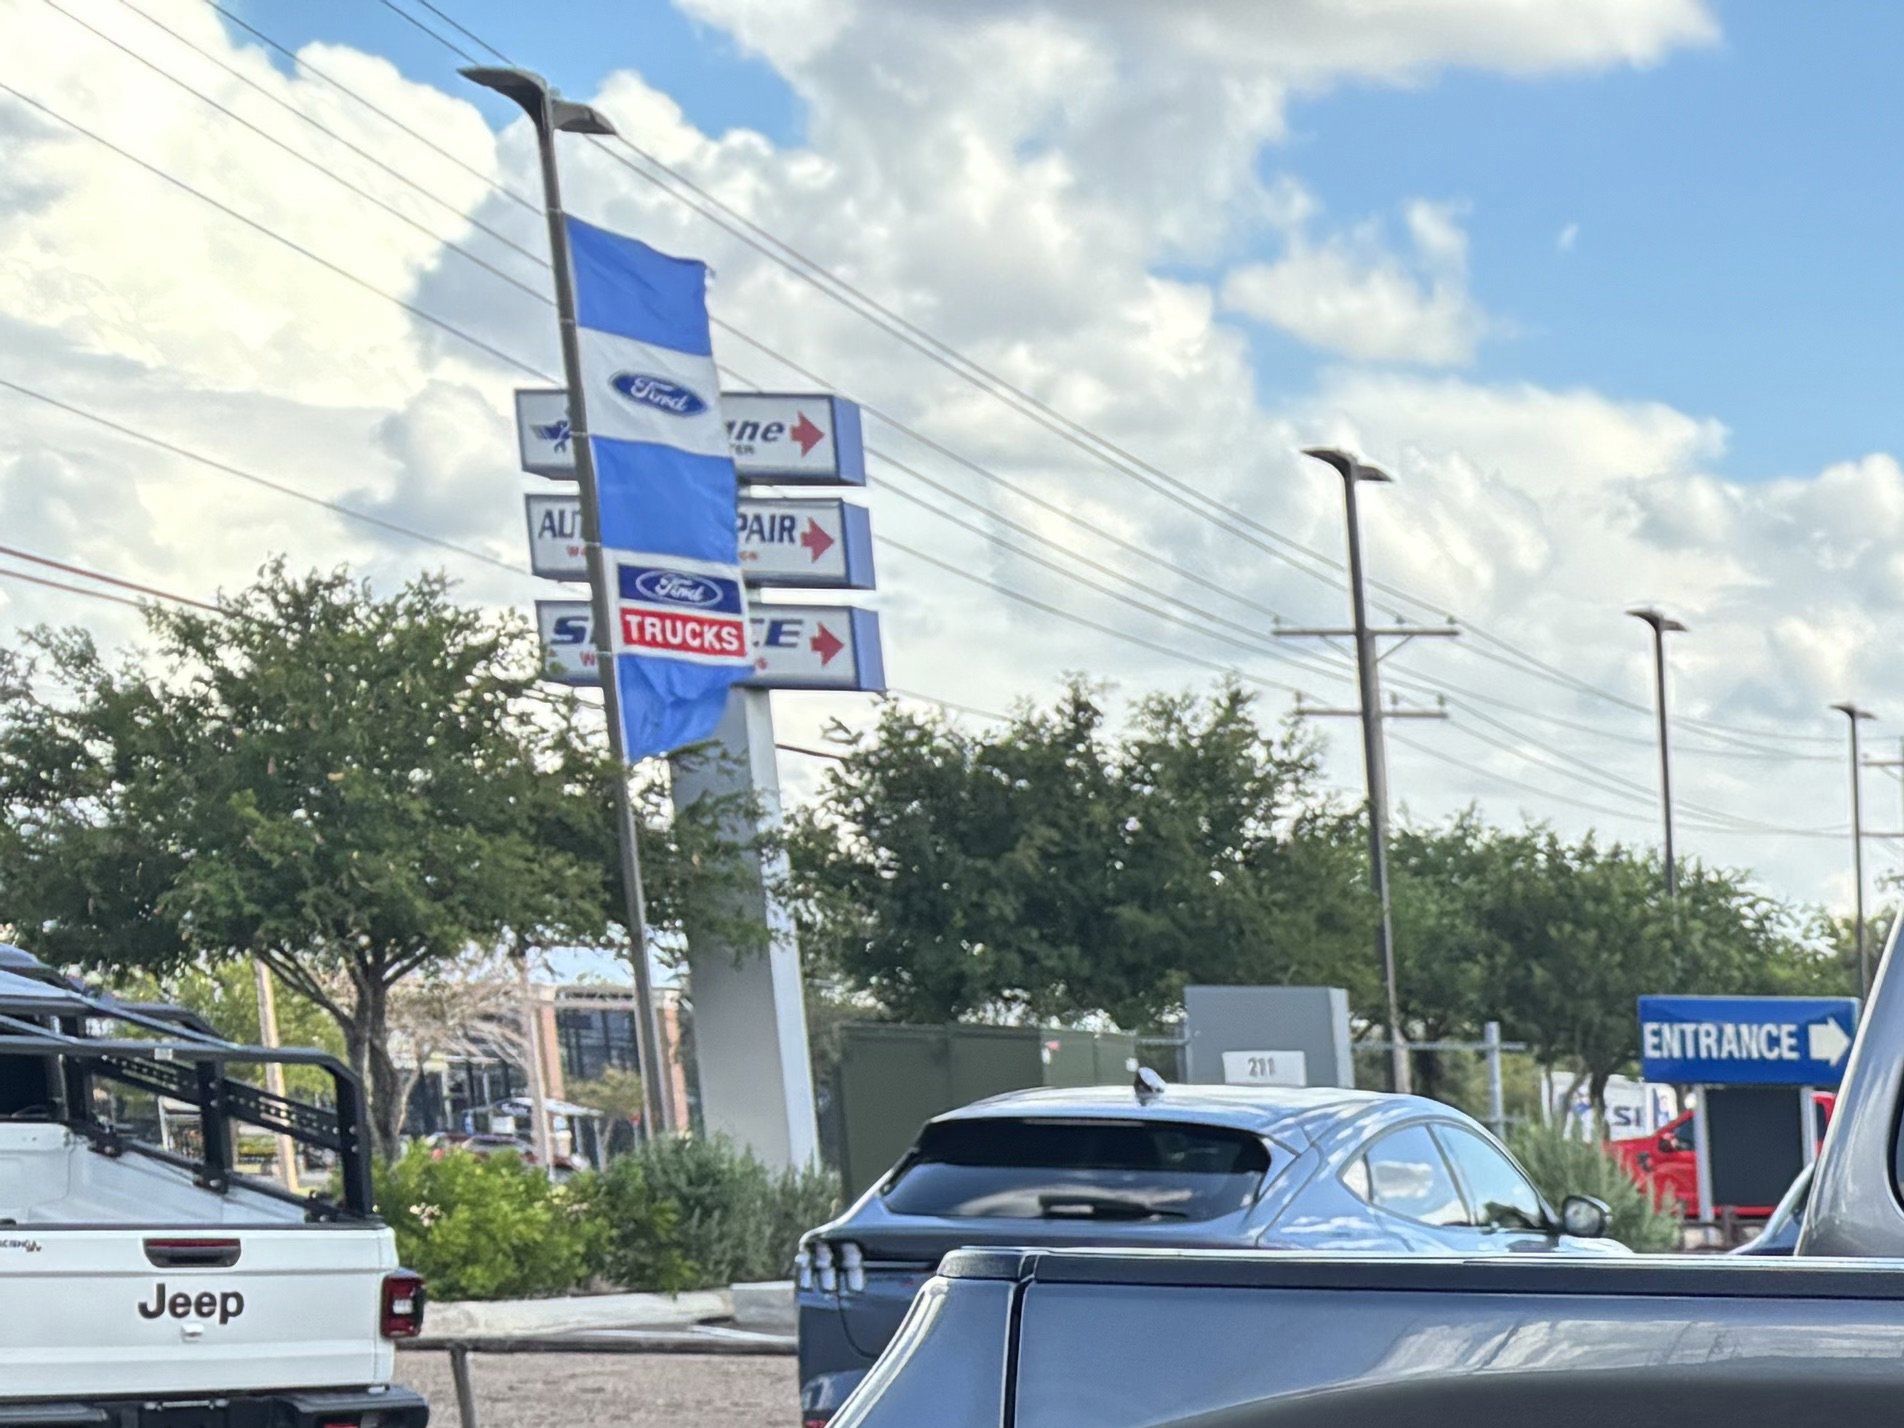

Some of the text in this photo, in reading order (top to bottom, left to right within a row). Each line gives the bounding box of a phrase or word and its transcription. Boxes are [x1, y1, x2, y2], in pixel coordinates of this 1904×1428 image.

[630, 376, 689, 412] Ford
[737, 513, 796, 544] PAIR
[654, 574, 706, 602] Ford
[624, 613, 740, 652] TRUCKS
[1642, 1021, 1801, 1060] ENTRANCE
[1247, 1056, 1276, 1078] 211
[137, 1283, 245, 1325] Jeep
